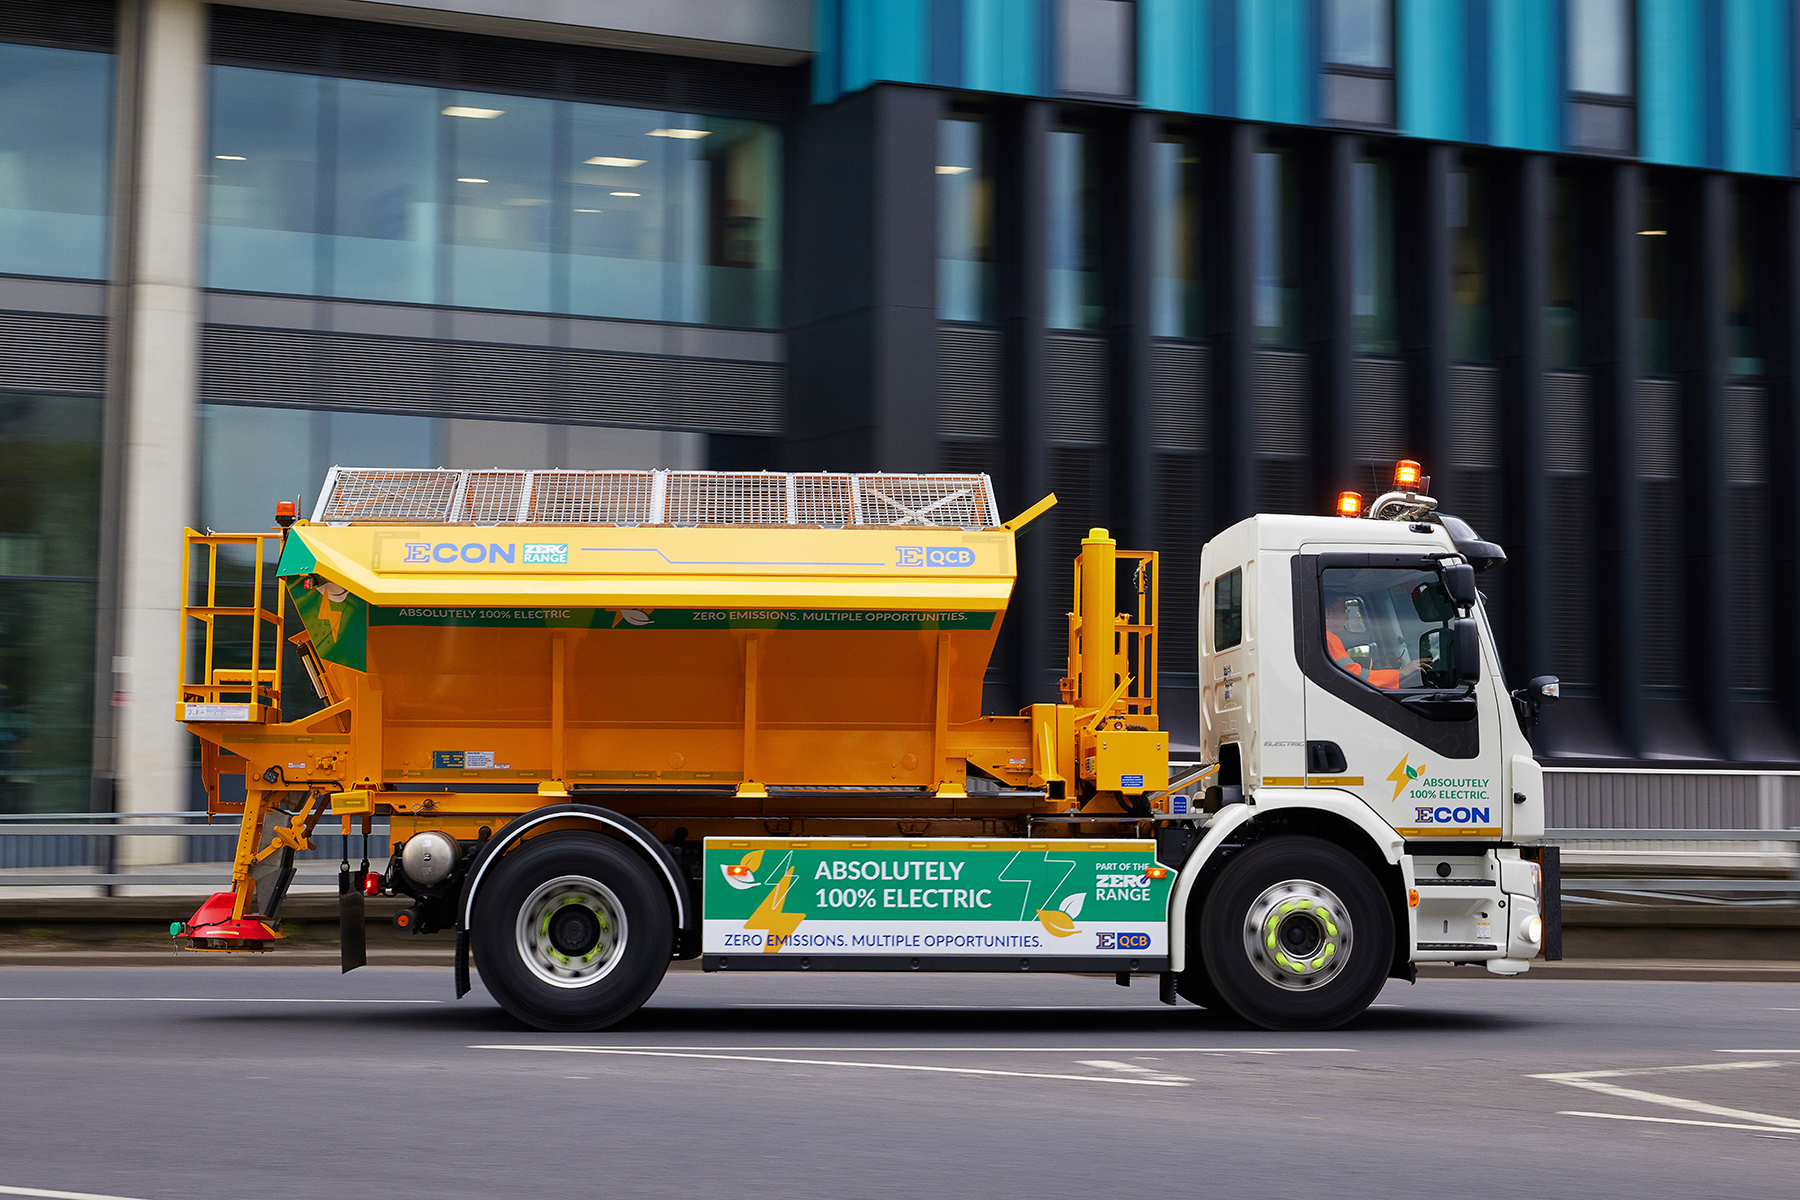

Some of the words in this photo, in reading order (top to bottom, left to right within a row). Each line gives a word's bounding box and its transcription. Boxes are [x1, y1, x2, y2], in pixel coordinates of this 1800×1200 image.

[404, 543, 516, 563] ECON
[524, 544, 568, 554] ZERO
[524, 553, 567, 563] RANGE
[929, 550, 970, 564] QCB
[399, 608, 477, 619] ABSOLUTELY
[479, 610, 511, 619] 100%
[514, 610, 570, 619] ELECTRIC
[693, 612, 726, 621] ZERO
[729, 611, 800, 621] EMISSIONS.
[803, 612, 862, 621] MULTIPLE
[865, 612, 968, 622] OPPORTUNITIES.
[1422, 778, 1490, 787] ABSOLUTELY
[1410, 790, 1436, 799] 100%
[1439, 790, 1490, 799] ELECTRIC.
[1415, 807, 1490, 823] ECON
[814, 861, 964, 881] ABSOLUTELY
[1096, 874, 1151, 888] ZERO
[816, 888, 877, 908] 100%
[883, 889, 992, 908] ELECTRIC
[1096, 888, 1151, 901] RANGE
[724, 934, 762, 947] ZERO
[766, 934, 848, 947] EMISSIONS.
[852, 934, 921, 947] MULTIPLE
[924, 935, 1043, 948] OPPORTUNITIES.
[1119, 935, 1148, 947] QCB
